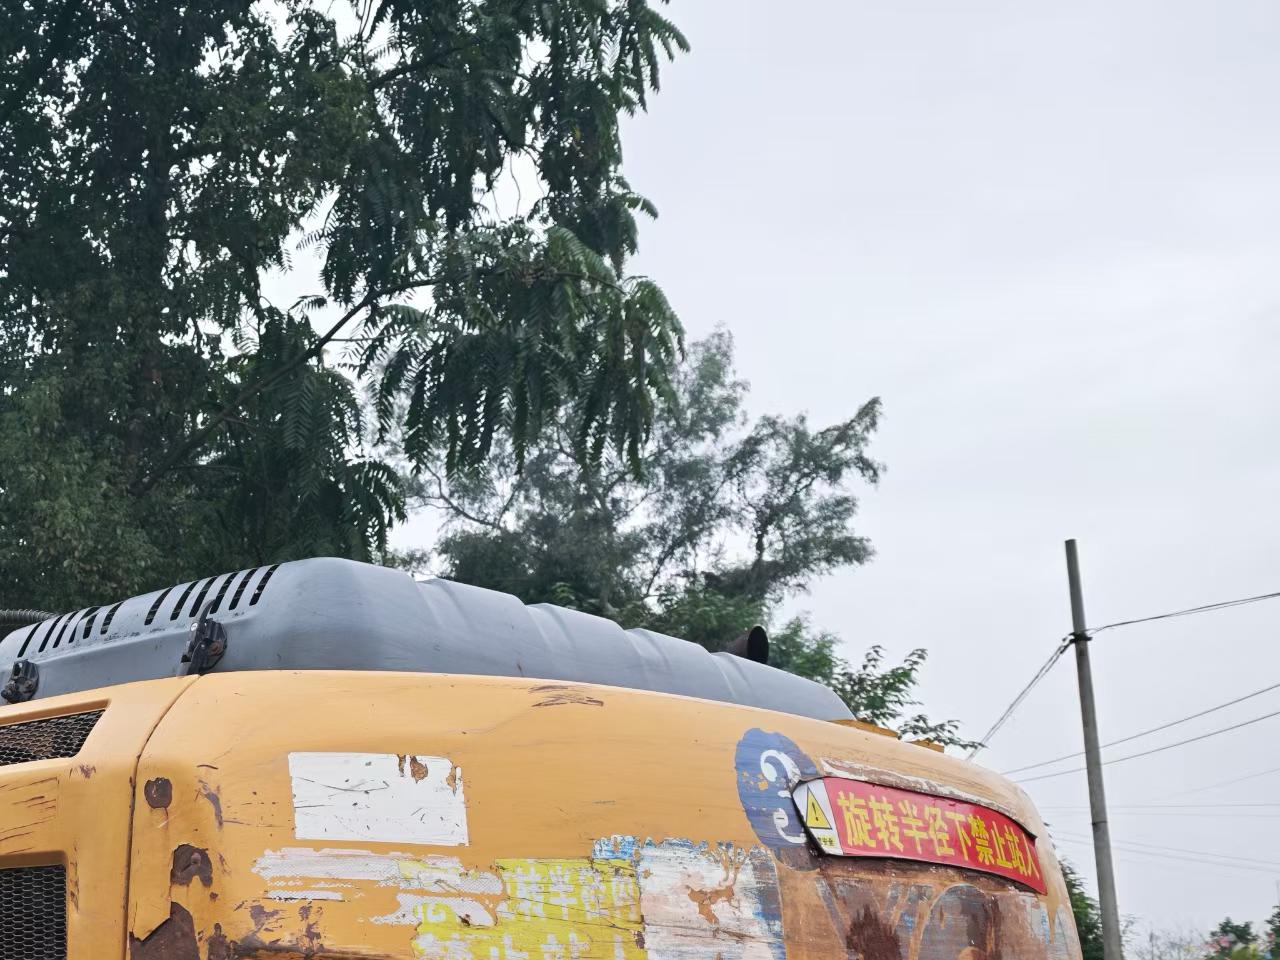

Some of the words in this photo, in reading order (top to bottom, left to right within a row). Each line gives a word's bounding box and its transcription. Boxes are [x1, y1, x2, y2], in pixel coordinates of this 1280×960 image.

[837, 791, 1040, 880] 旋转半径下禁止站人
